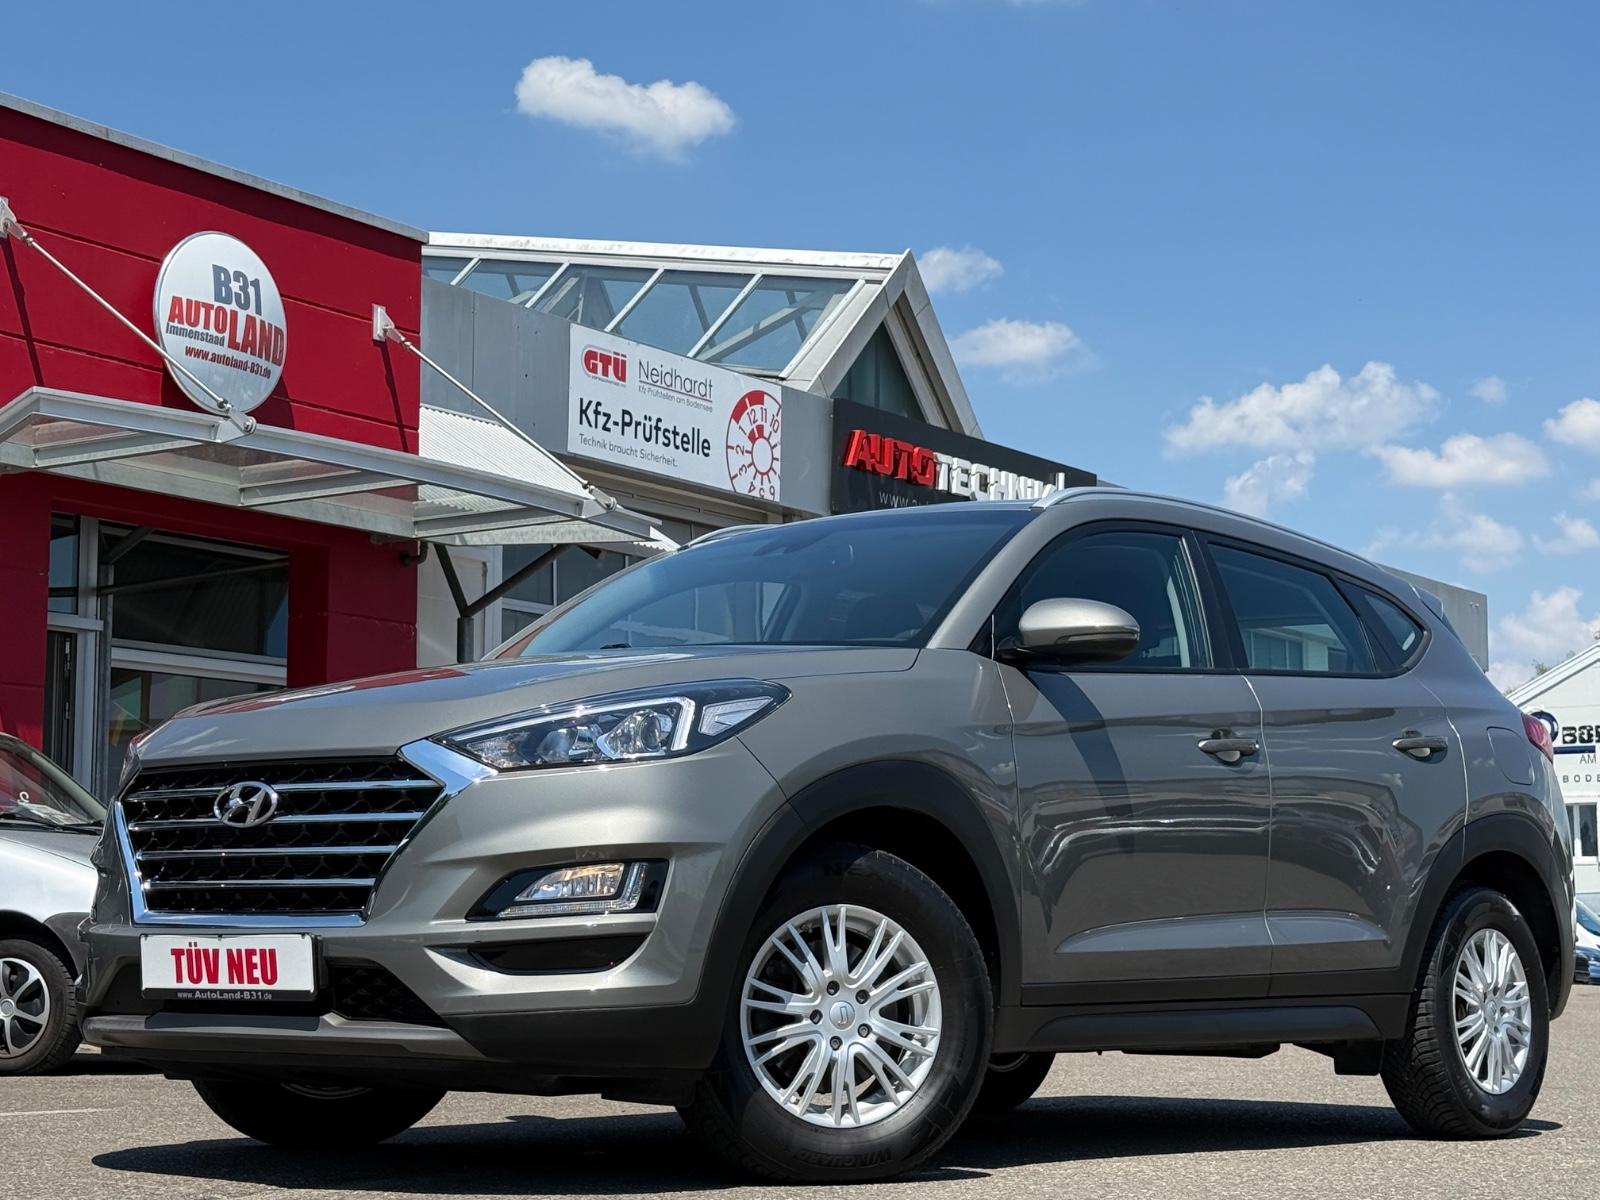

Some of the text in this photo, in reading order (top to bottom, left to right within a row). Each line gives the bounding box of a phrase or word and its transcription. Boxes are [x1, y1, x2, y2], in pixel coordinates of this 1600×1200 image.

[212, 264, 262, 316] B31
[165, 322, 225, 347] Immenstaad
[584, 349, 627, 383] GTÜ
[638, 359, 713, 399] Neidhardt
[579, 397, 711, 458] Kfz-Prüfstelle
[579, 433, 678, 467] Technik braucht Sicherheit.
[1579, 754, 1597, 765] AM
[170, 941, 278, 986] TÜV NEU
[177, 990, 272, 1000] www.AutoLand-B31.de
